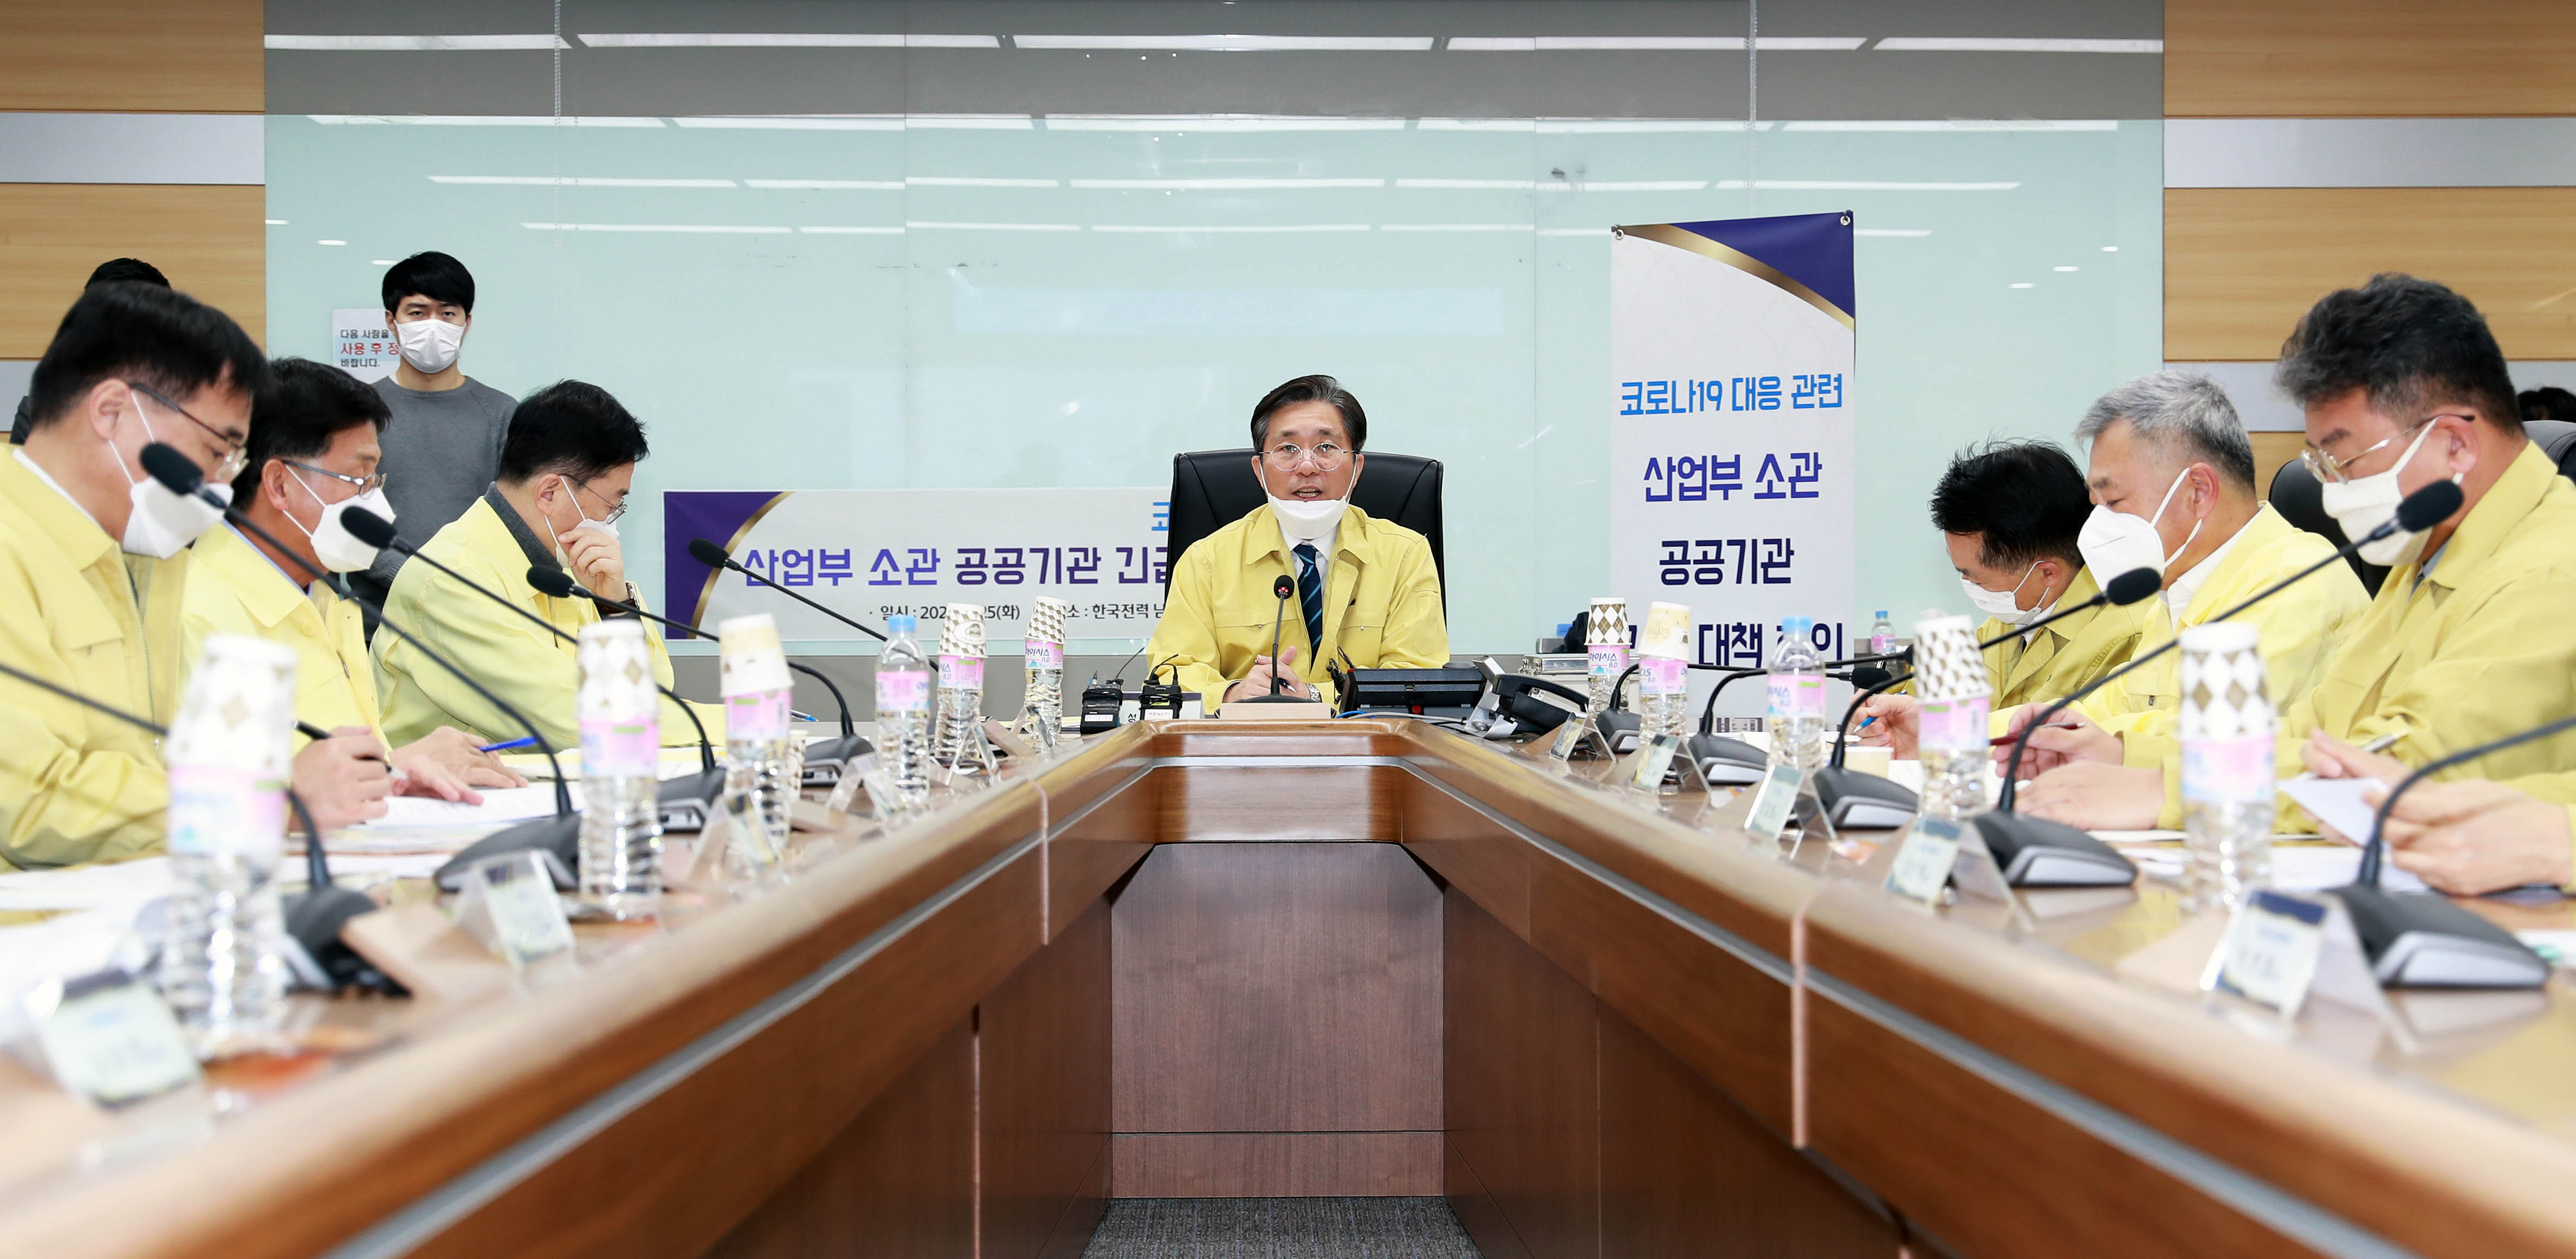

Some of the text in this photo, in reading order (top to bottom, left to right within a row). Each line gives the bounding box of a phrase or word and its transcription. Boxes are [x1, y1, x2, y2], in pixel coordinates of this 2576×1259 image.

[341, 330, 389, 339] 다음 사람을
[341, 343, 365, 355] 사용
[371, 343, 382, 355] 후
[341, 358, 380, 367] 바랍니다.
[1620, 373, 1842, 415] 코로나19 대응 관련
[1643, 452, 1822, 502] 산업부 소관
[745, 548, 853, 587] 산업부
[868, 548, 941, 586] 소관
[955, 547, 1102, 585] 공공기관
[1659, 538, 1795, 585] 공공기관
[1067, 605, 1080, 617] 소
[1092, 604, 1148, 619] 한국전력
[1699, 622, 1763, 669] 대책
[1589, 653, 1617, 662] 아이시스
[1639, 668, 1652, 676] CIS
